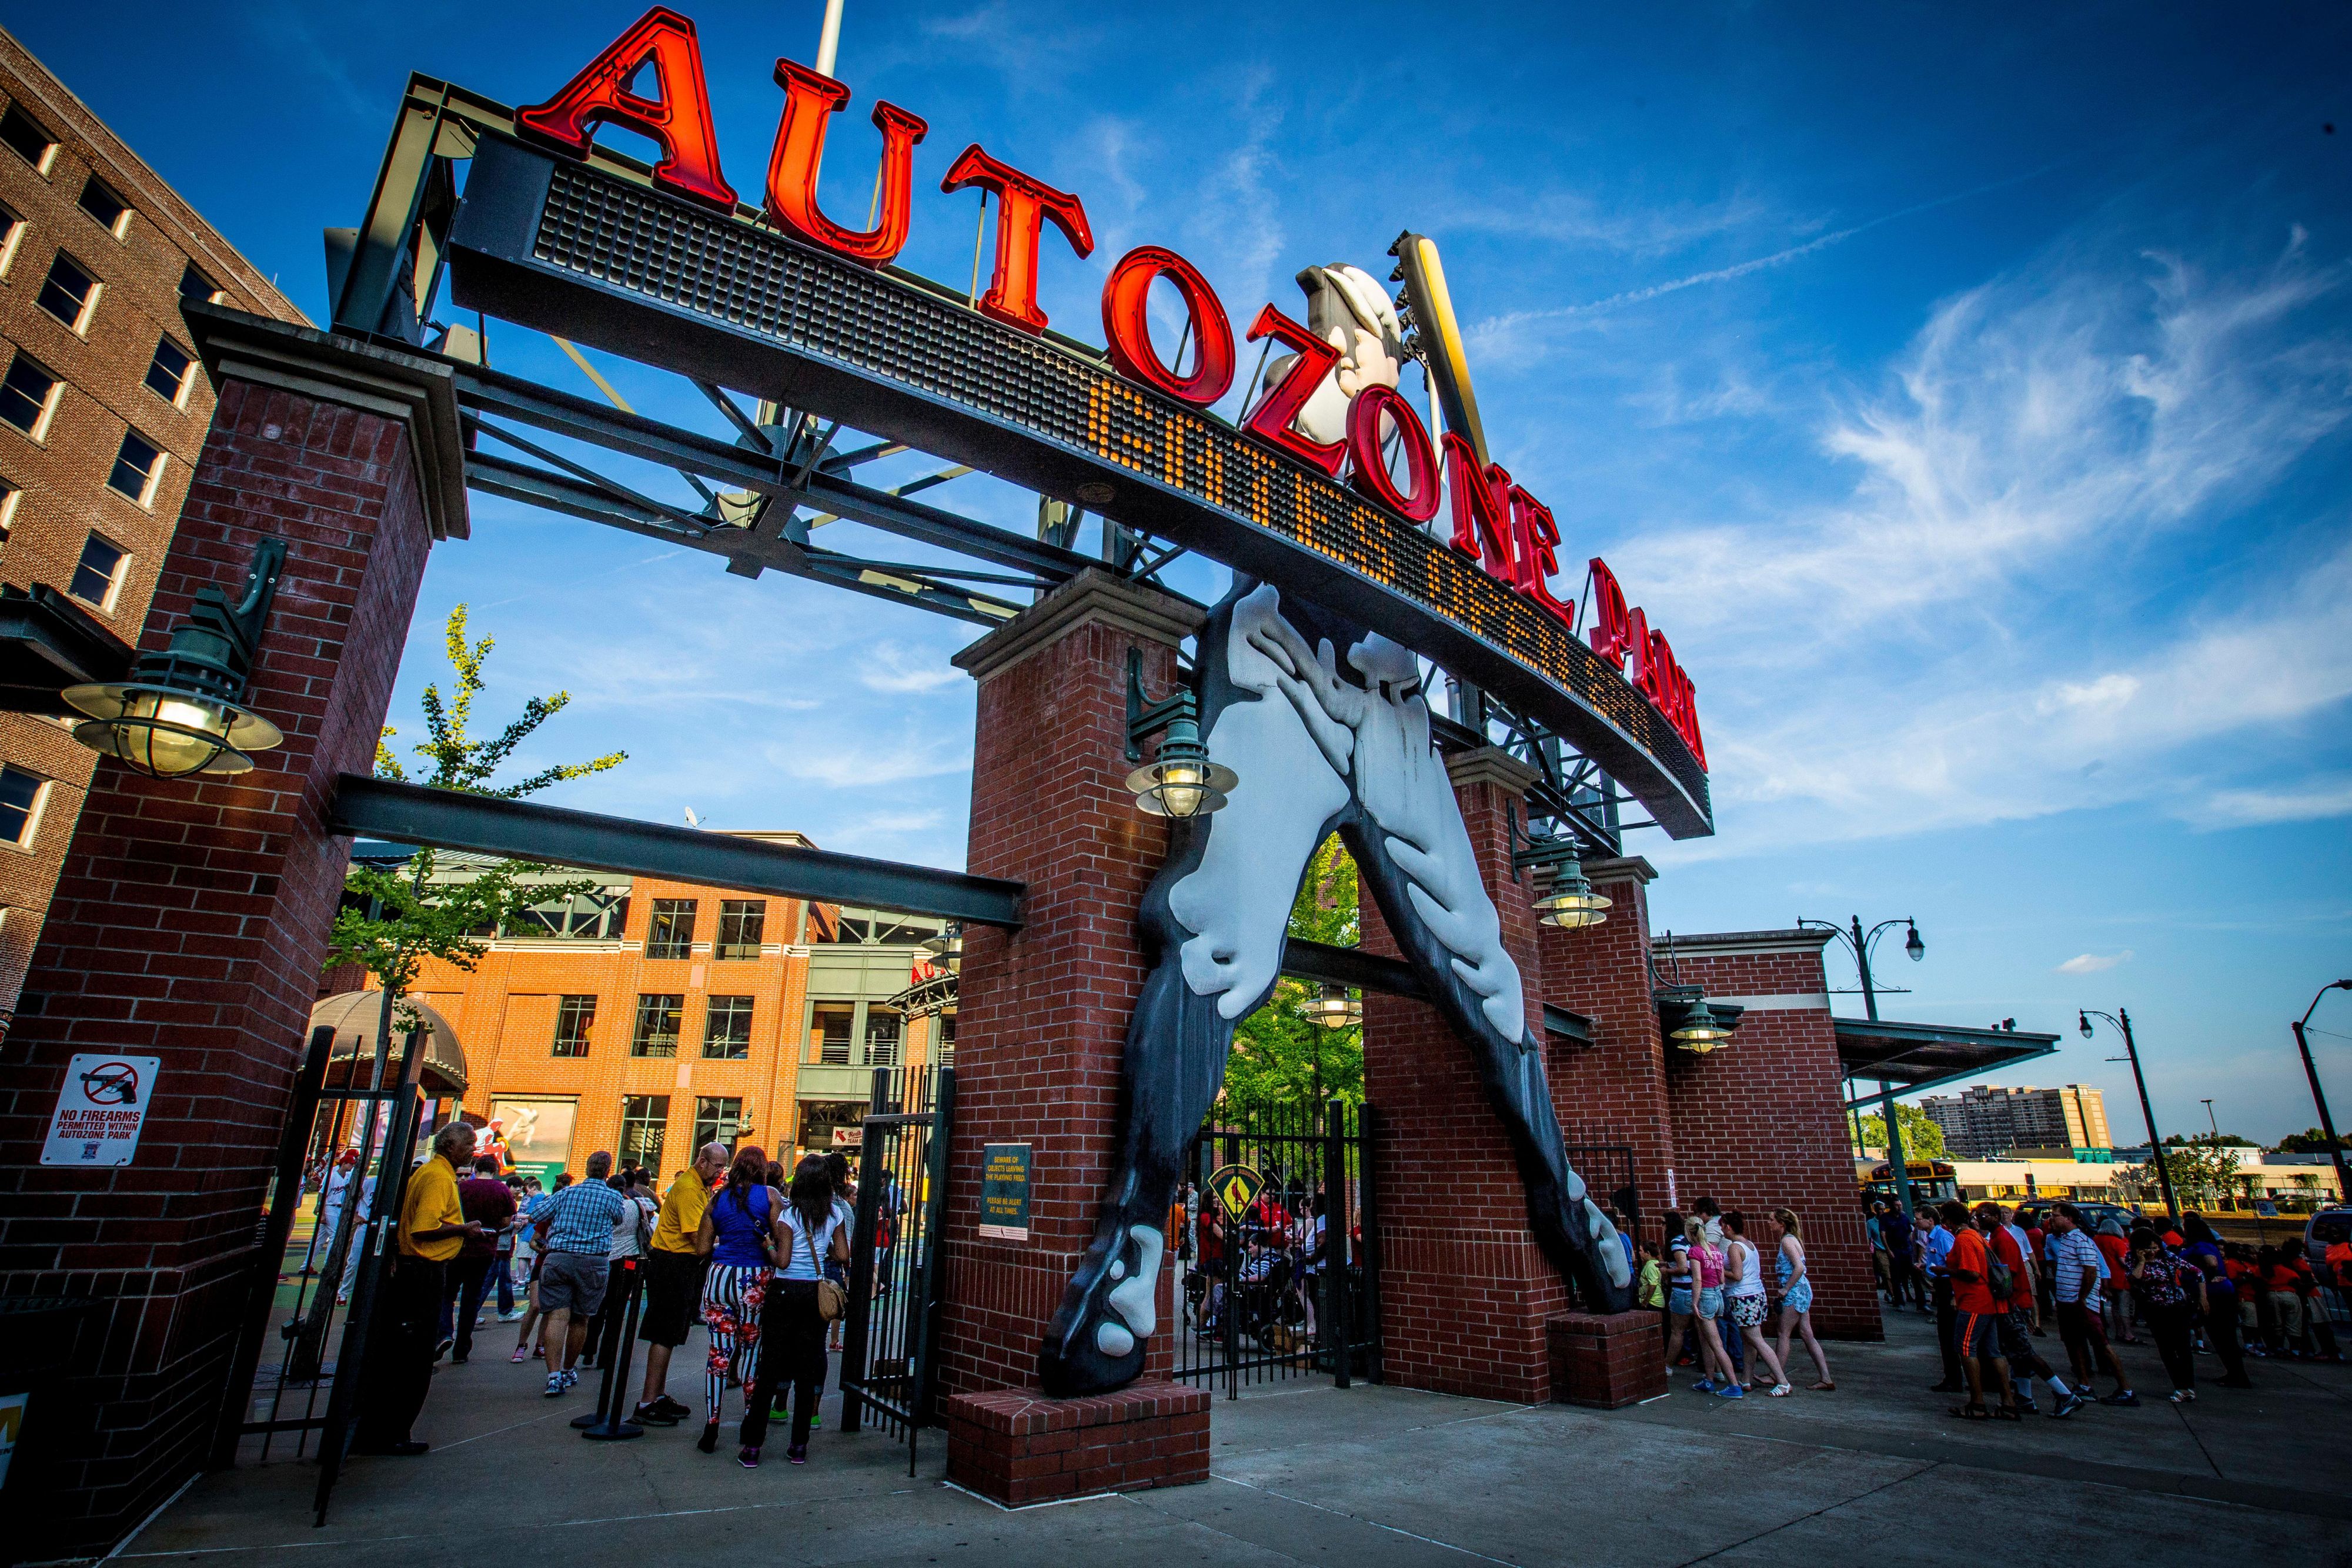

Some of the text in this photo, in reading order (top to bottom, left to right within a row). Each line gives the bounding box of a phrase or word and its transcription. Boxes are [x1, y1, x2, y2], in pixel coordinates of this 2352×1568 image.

[514, 5, 1709, 774] AUTOZONE PARK
[1088, 379, 1396, 586] GATES
[1426, 547, 1571, 693] OPEN
[59, 1109, 141, 1122] NO FIREARMS
[56, 1121, 139, 1131] PERMITTED WITHIN
[58, 1131, 132, 1139] AUTOZONE PARK
